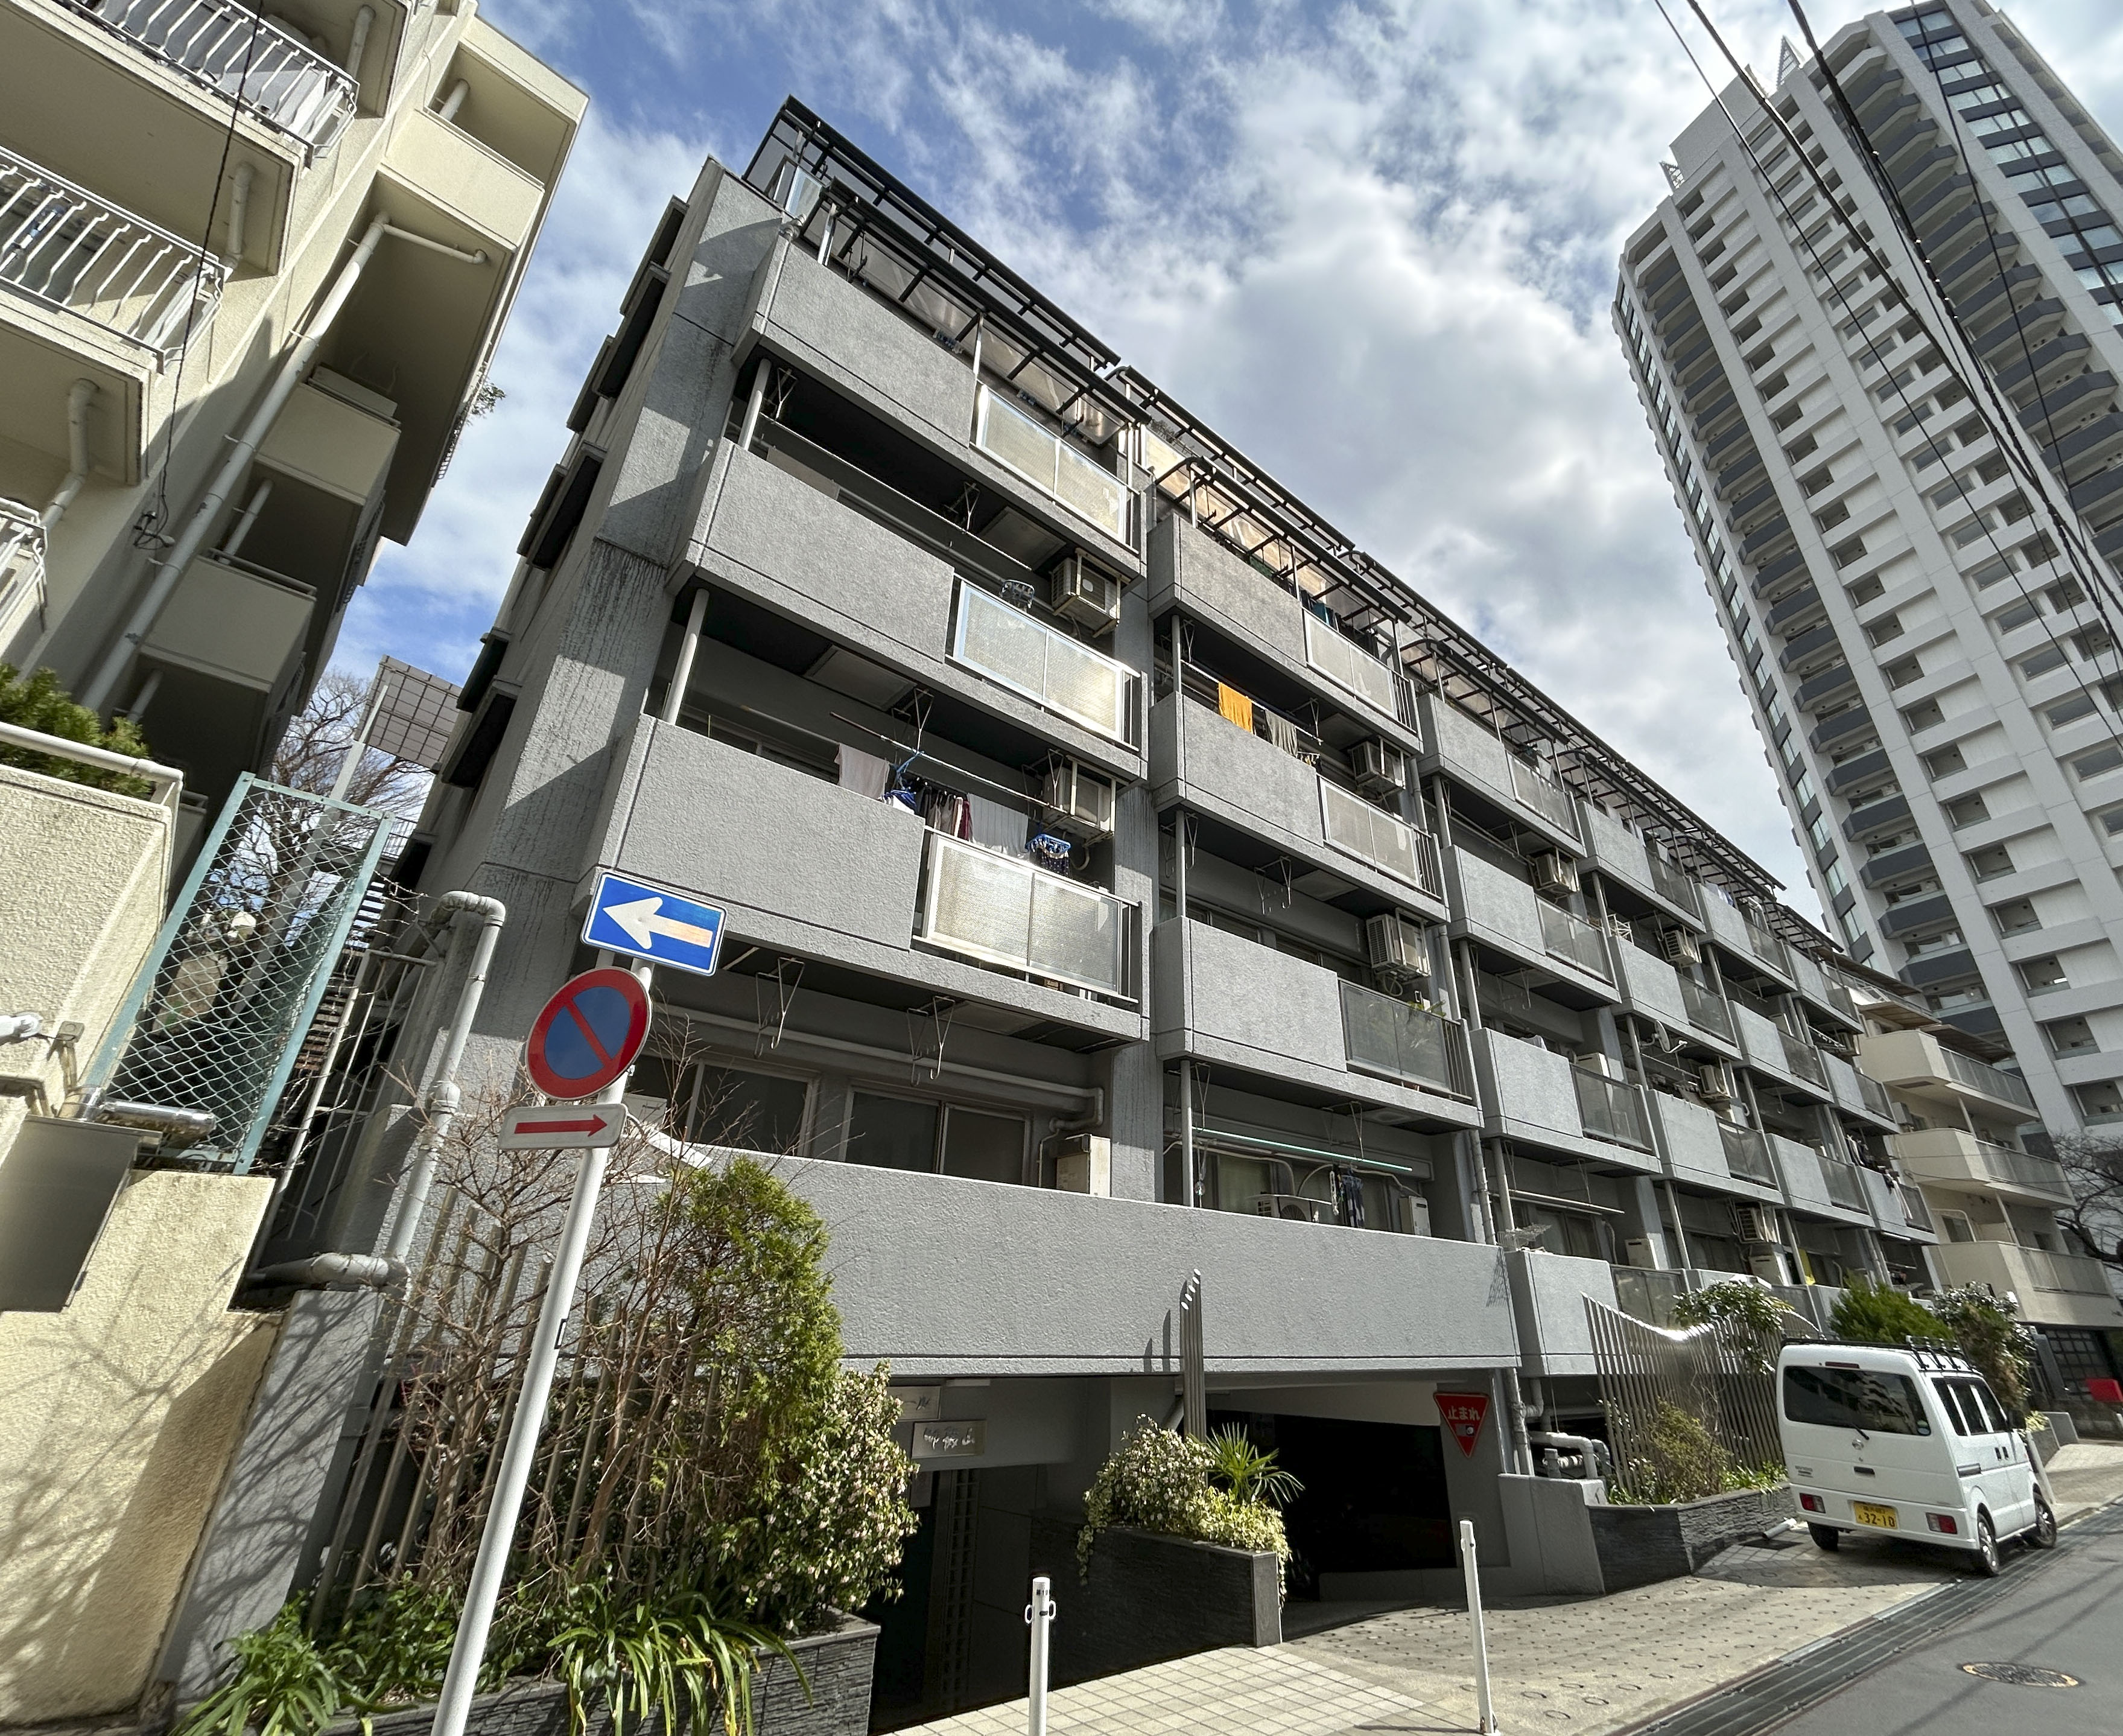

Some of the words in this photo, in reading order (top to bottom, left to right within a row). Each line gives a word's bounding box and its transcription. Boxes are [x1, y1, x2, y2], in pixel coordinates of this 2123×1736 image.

[1447, 1405, 1480, 1421] 止まれ
[1864, 1512, 1895, 1527] 32-10
